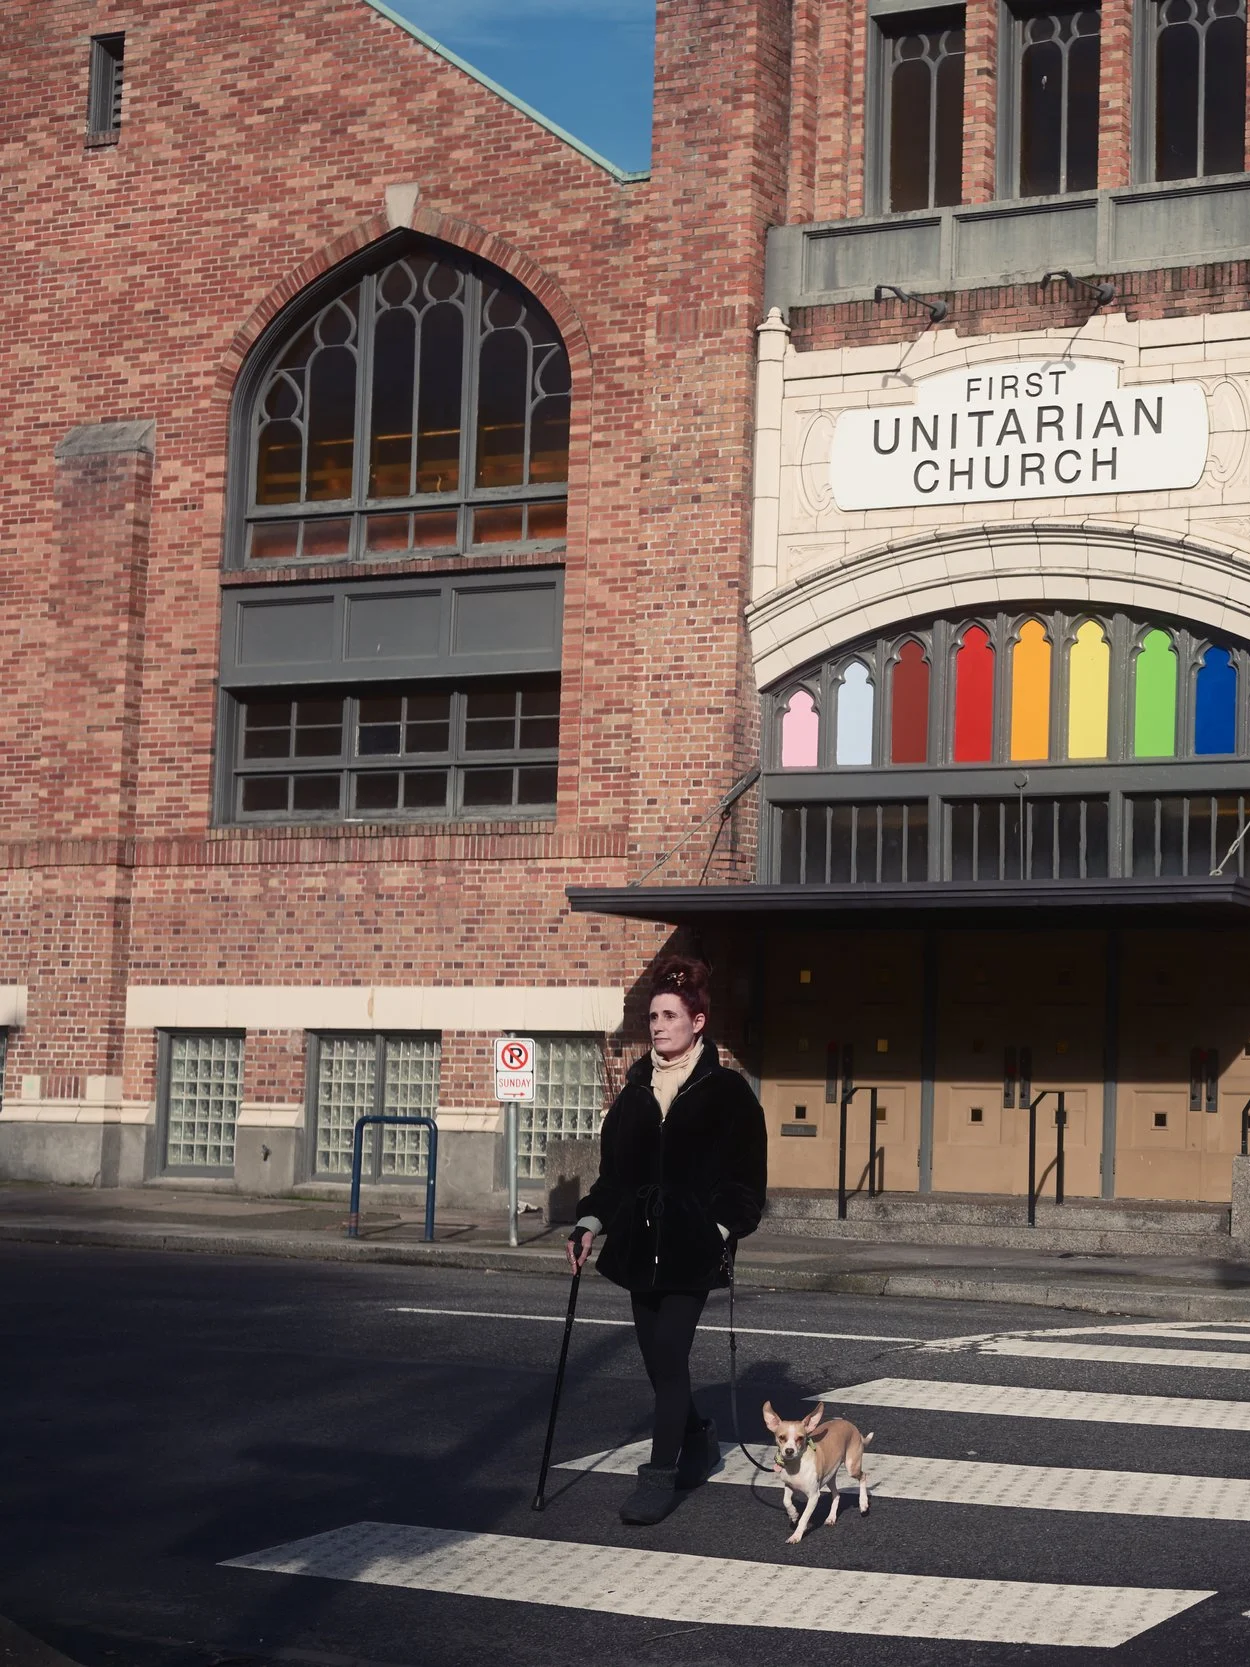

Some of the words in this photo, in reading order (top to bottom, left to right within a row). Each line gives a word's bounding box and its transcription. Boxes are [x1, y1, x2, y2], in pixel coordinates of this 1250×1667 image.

[966, 371, 1067, 402] FIRST
[873, 397, 1163, 455] UNITARIAN
[913, 447, 1117, 494] CHURCH
[499, 1078, 531, 1088] SUNDAY
